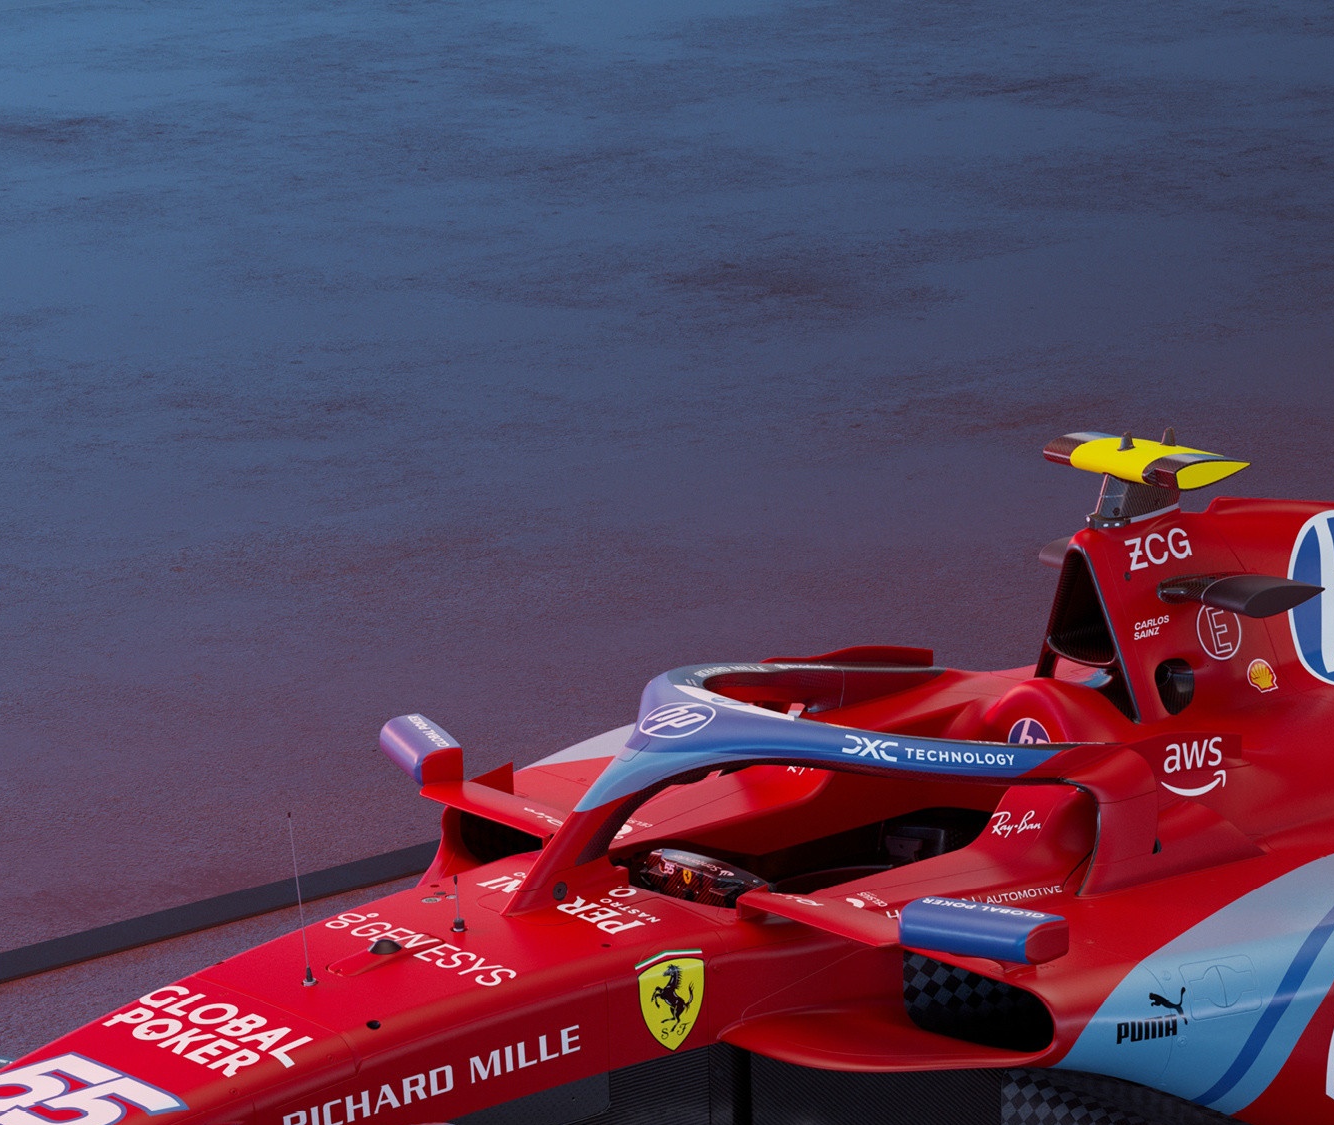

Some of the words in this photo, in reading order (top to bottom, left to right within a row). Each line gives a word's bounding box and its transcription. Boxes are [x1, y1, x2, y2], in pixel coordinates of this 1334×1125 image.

[1124, 528, 1193, 571] ZCG
[1134, 614, 1170, 631] CARLOS
[1134, 626, 1160, 641] SAINZ
[641, 703, 712, 737] hp
[842, 734, 899, 762] DXC
[905, 747, 1015, 766] TECHNOLOGY
[1163, 736, 1223, 773] aws
[599, 898, 661, 923] NASTRO
[922, 897, 977, 911] POKER
[986, 885, 1063, 905] AUTOMOTIVE
[981, 904, 1046, 919] GLOBAL
[351, 921, 517, 987] GENESYS
[102, 1007, 261, 1078] POKER
[139, 985, 314, 1069] GLOBAL
[1117, 1014, 1178, 1044] PUMA
[469, 1024, 582, 1084] MILLE
